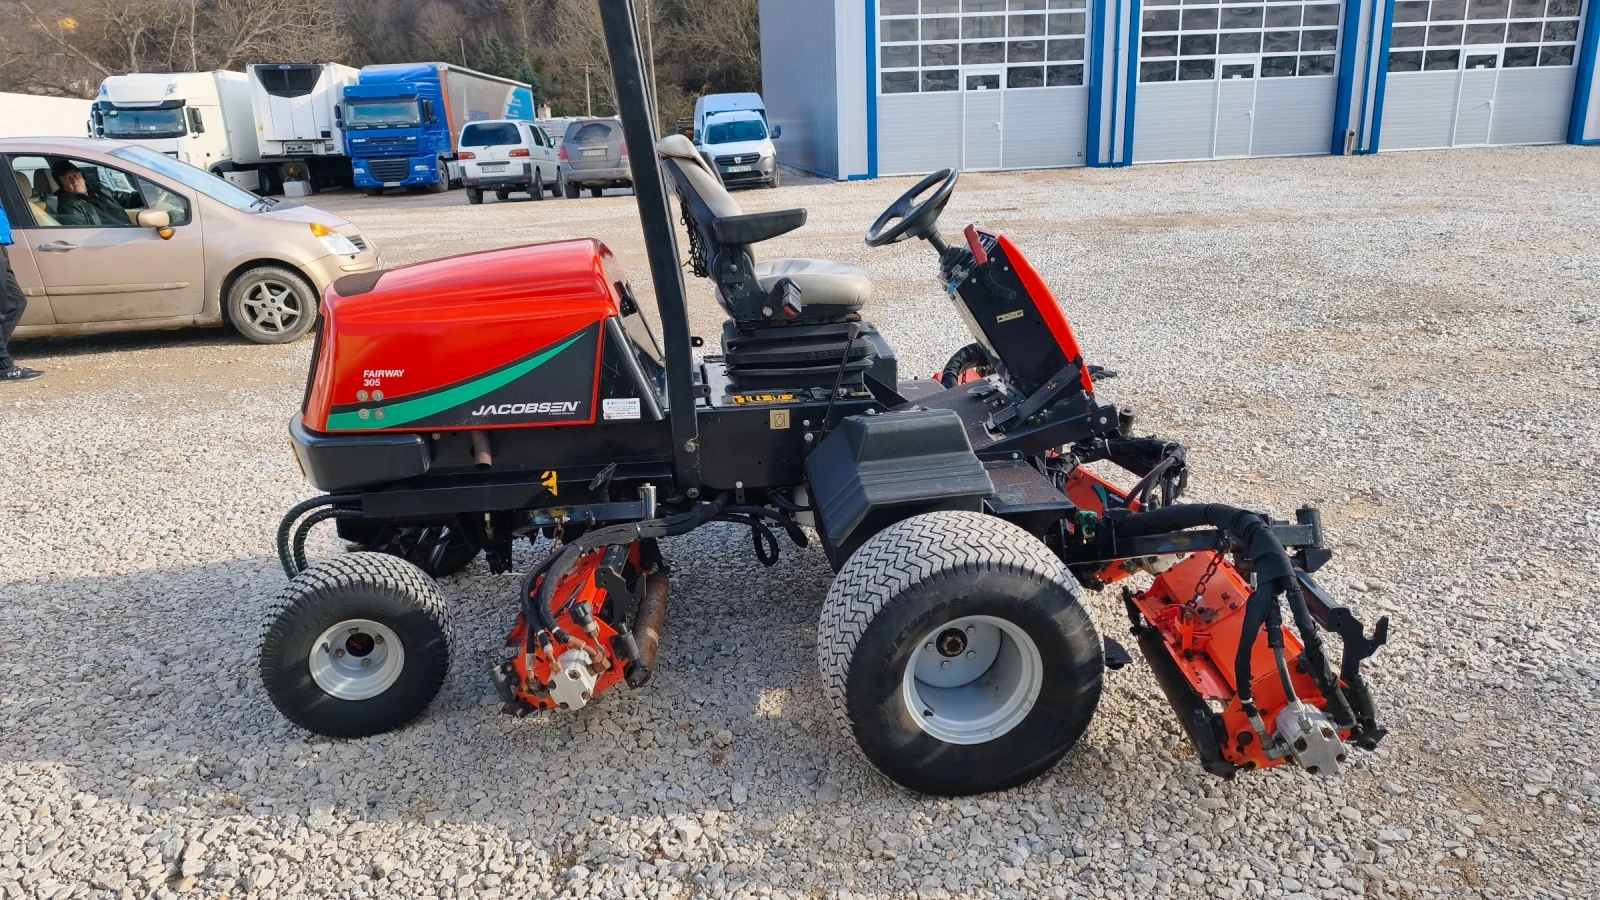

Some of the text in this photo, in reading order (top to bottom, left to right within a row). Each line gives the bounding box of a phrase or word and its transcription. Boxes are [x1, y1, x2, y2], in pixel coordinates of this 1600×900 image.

[363, 369, 405, 378] FAIRWAY
[363, 379, 381, 387] 305
[471, 401, 578, 416] JACOBSEN
